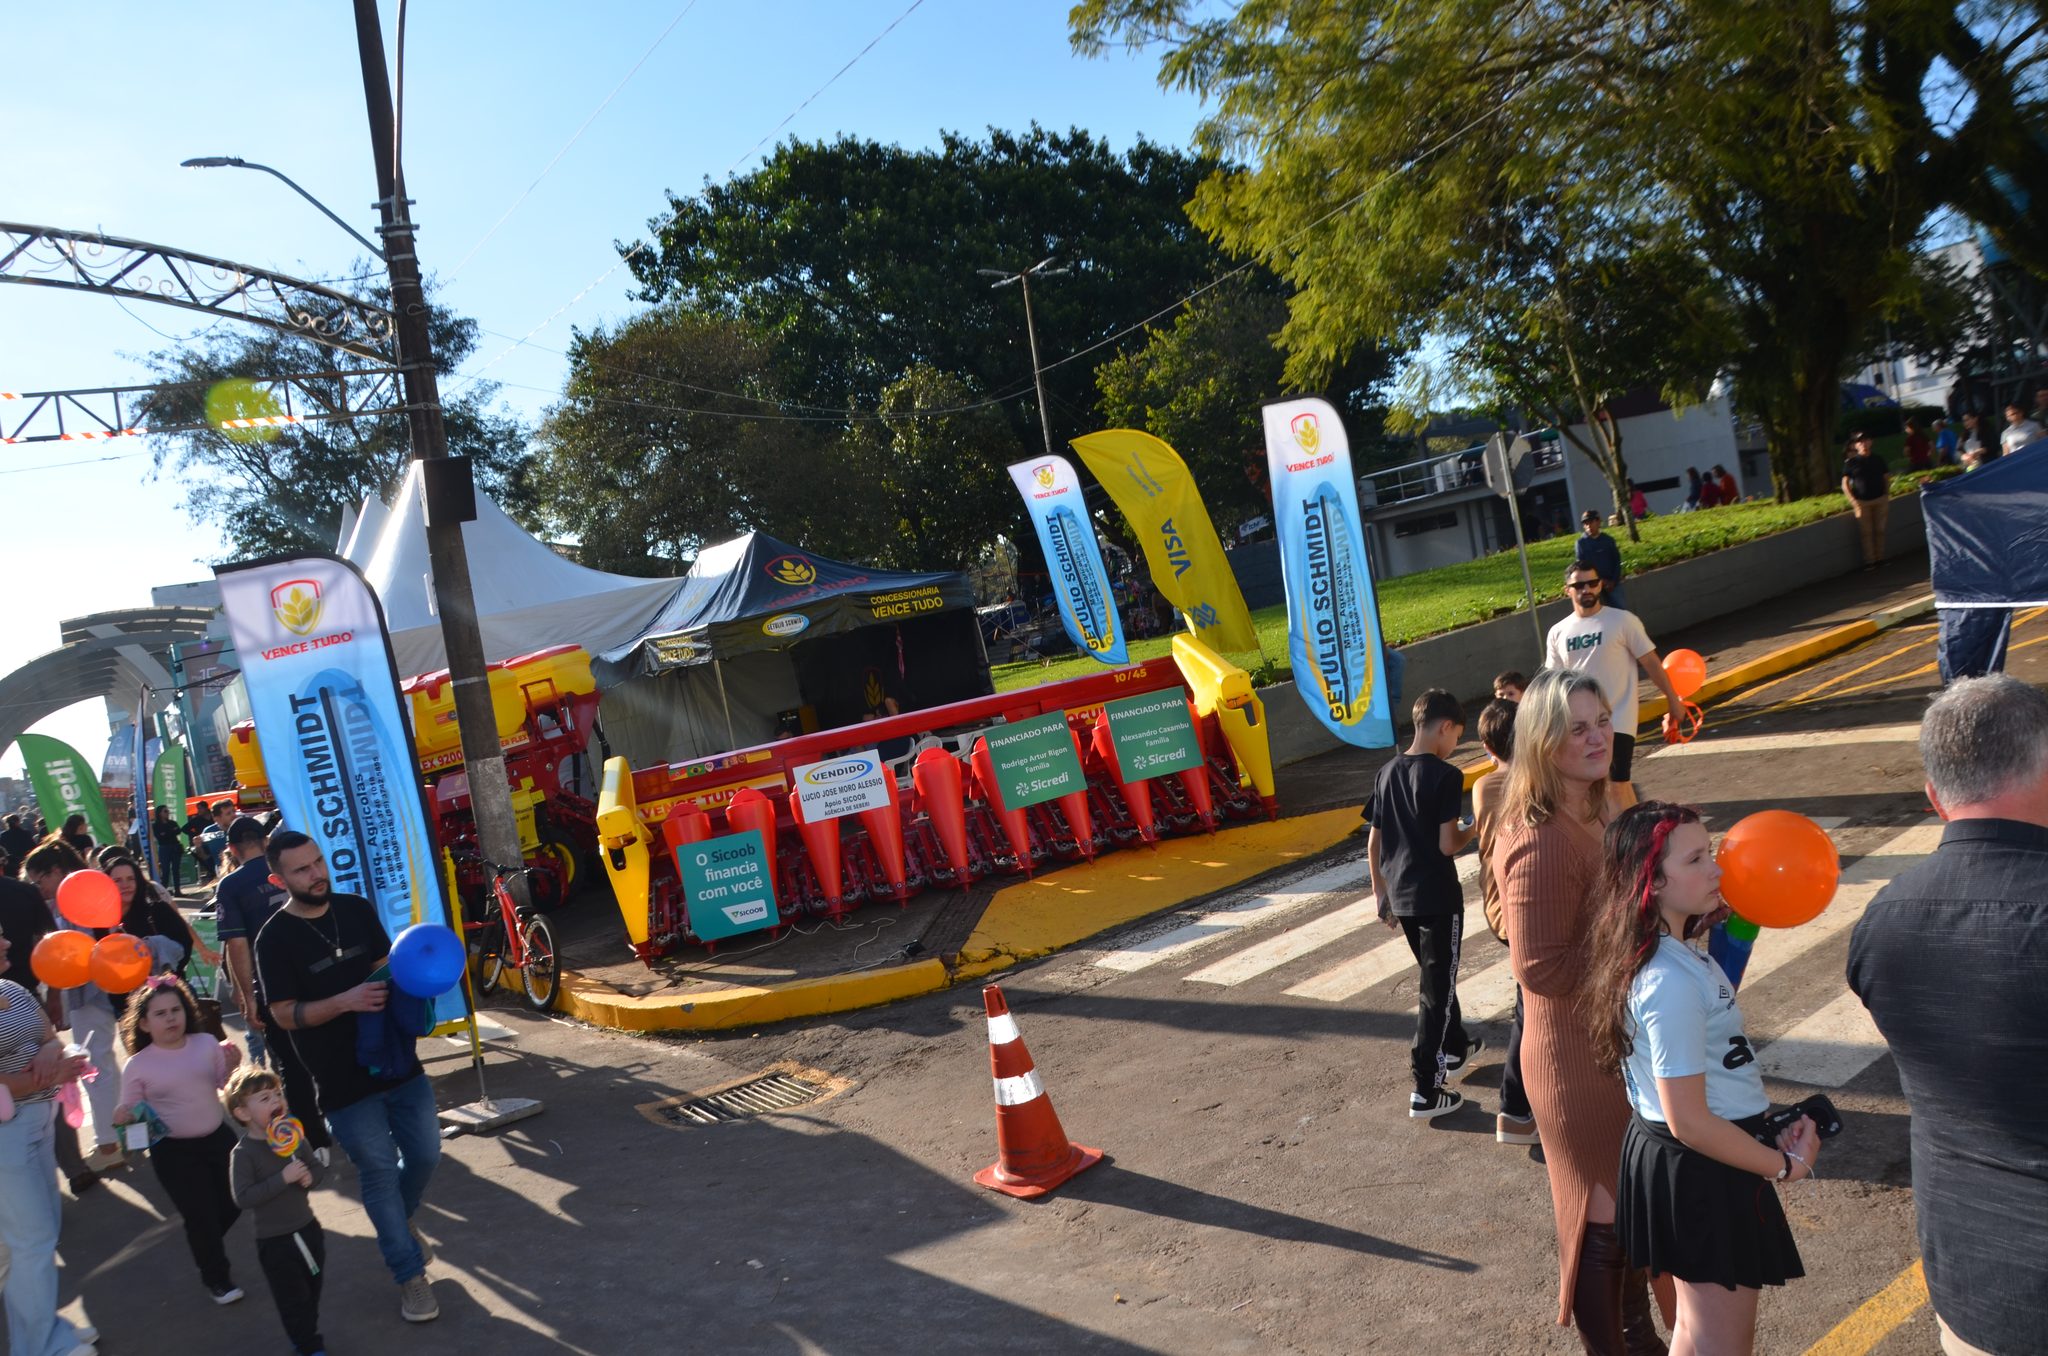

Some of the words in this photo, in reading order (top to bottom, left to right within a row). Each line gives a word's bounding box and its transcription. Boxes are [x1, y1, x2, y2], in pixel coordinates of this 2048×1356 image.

[1285, 460, 1315, 472] VENCE
[1316, 453, 1334, 467] TUDO
[1045, 514, 1076, 582] SCHMIDT
[1161, 517, 1192, 578] VISA
[1302, 499, 1330, 612] SCHMIDT
[870, 585, 940, 605] CONCESSIONÁRIA
[871, 600, 911, 618] VENCE
[912, 596, 944, 615] TUDO
[1070, 586, 1100, 651] GETULIO
[261, 641, 309, 661] VENCE
[311, 631, 353, 650] TUDO
[1567, 631, 1602, 652] HIGH
[1316, 618, 1345, 723] GETULIO
[1110, 704, 1161, 721] FINANCIADO
[1161, 699, 1183, 710] PARA
[990, 728, 1041, 748] FINANCIADO
[1042, 722, 1064, 734] PARA
[1121, 729, 1158, 742] Alexsandro
[1158, 722, 1189, 734] Caxambu
[288, 693, 350, 839] SCHMIDT
[437, 750, 463, 765] 9200
[1001, 758, 1028, 770] Rodrigo
[1029, 753, 1047, 762] Artur
[1048, 747, 1068, 757] Rigon
[1148, 748, 1186, 765] Sicredi
[812, 763, 866, 781] VENDIDO
[1031, 771, 1069, 792] Sicredi
[801, 791, 821, 802] LUCIO
[822, 787, 838, 798] JOSE
[838, 783, 857, 794] MORO
[857, 777, 883, 789] ALESSIO
[824, 799, 842, 809] Apoio
[842, 792, 867, 804] SICOOB
[355, 773, 378, 847] Agricolas
[696, 853, 708, 866] O
[711, 842, 756, 863] Sicoob
[705, 861, 759, 882] financia
[698, 886, 728, 901] com
[731, 876, 764, 894] você
[739, 906, 764, 917] SICOOB
